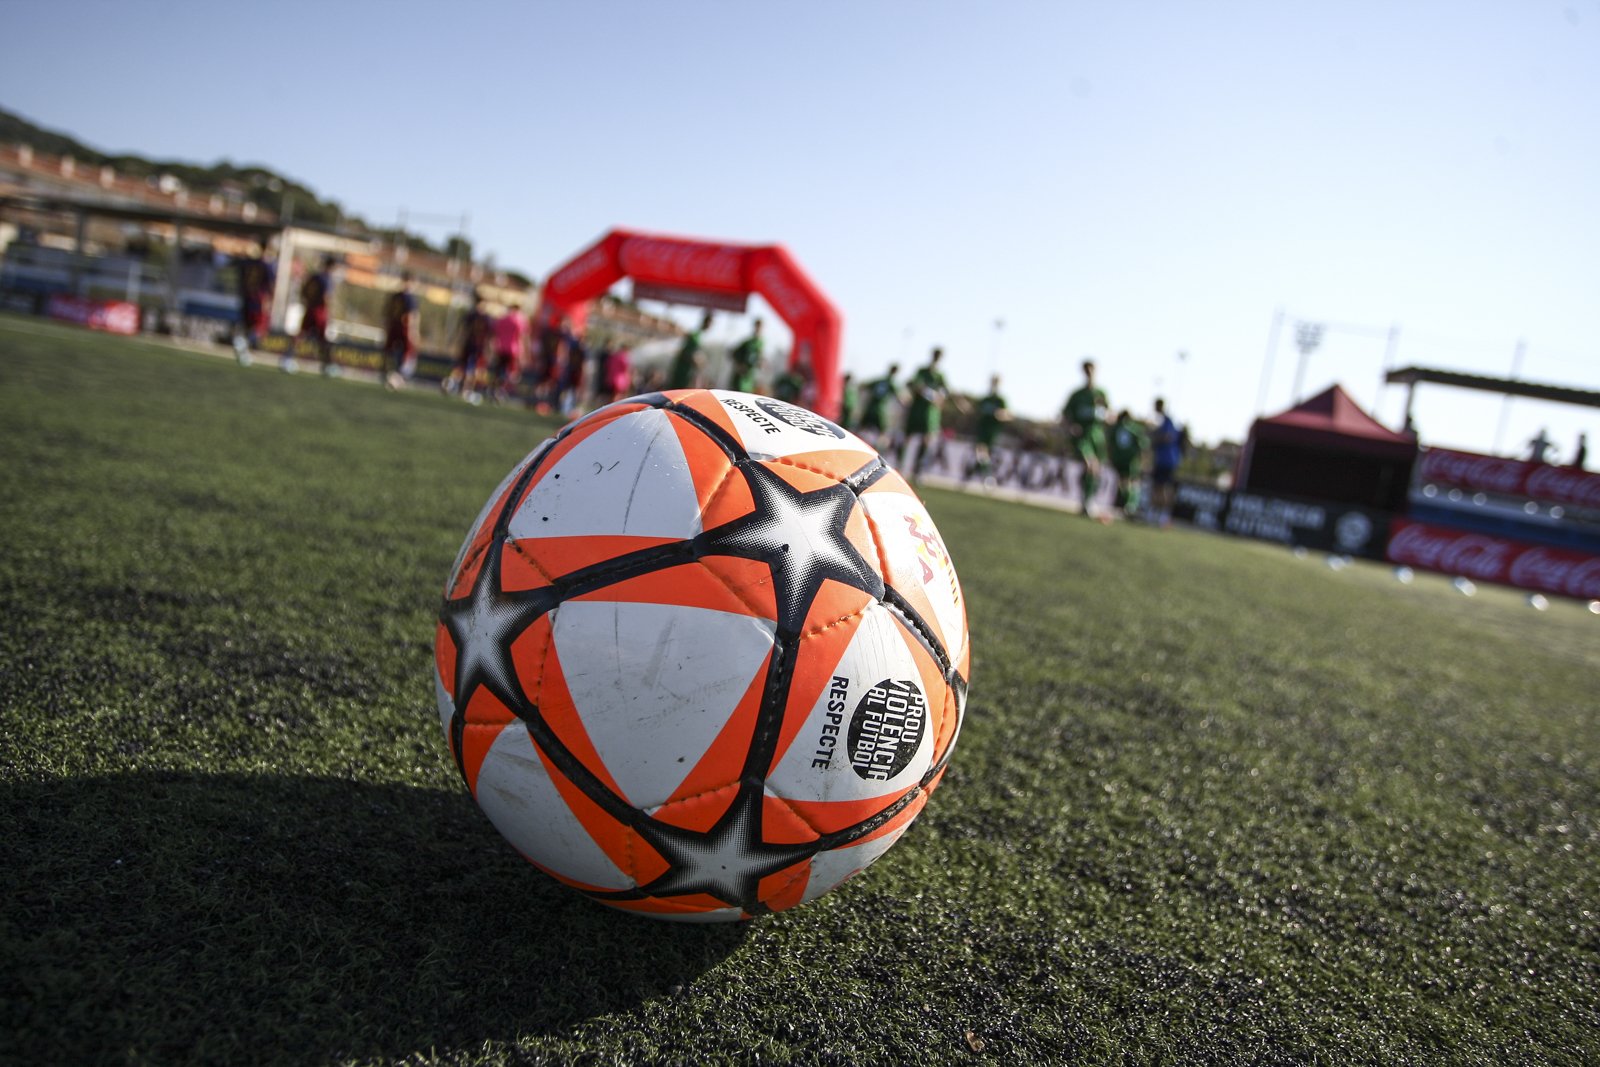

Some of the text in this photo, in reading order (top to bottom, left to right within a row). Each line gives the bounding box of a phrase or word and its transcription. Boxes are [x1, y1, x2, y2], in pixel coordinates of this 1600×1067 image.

[720, 398, 782, 435] RESPECTE
[811, 675, 850, 770] RESPECTE
[852, 687, 888, 770] AL FUTBOL
[866, 679, 912, 782] VIOLENCIA
[900, 692, 924, 744] PROU
